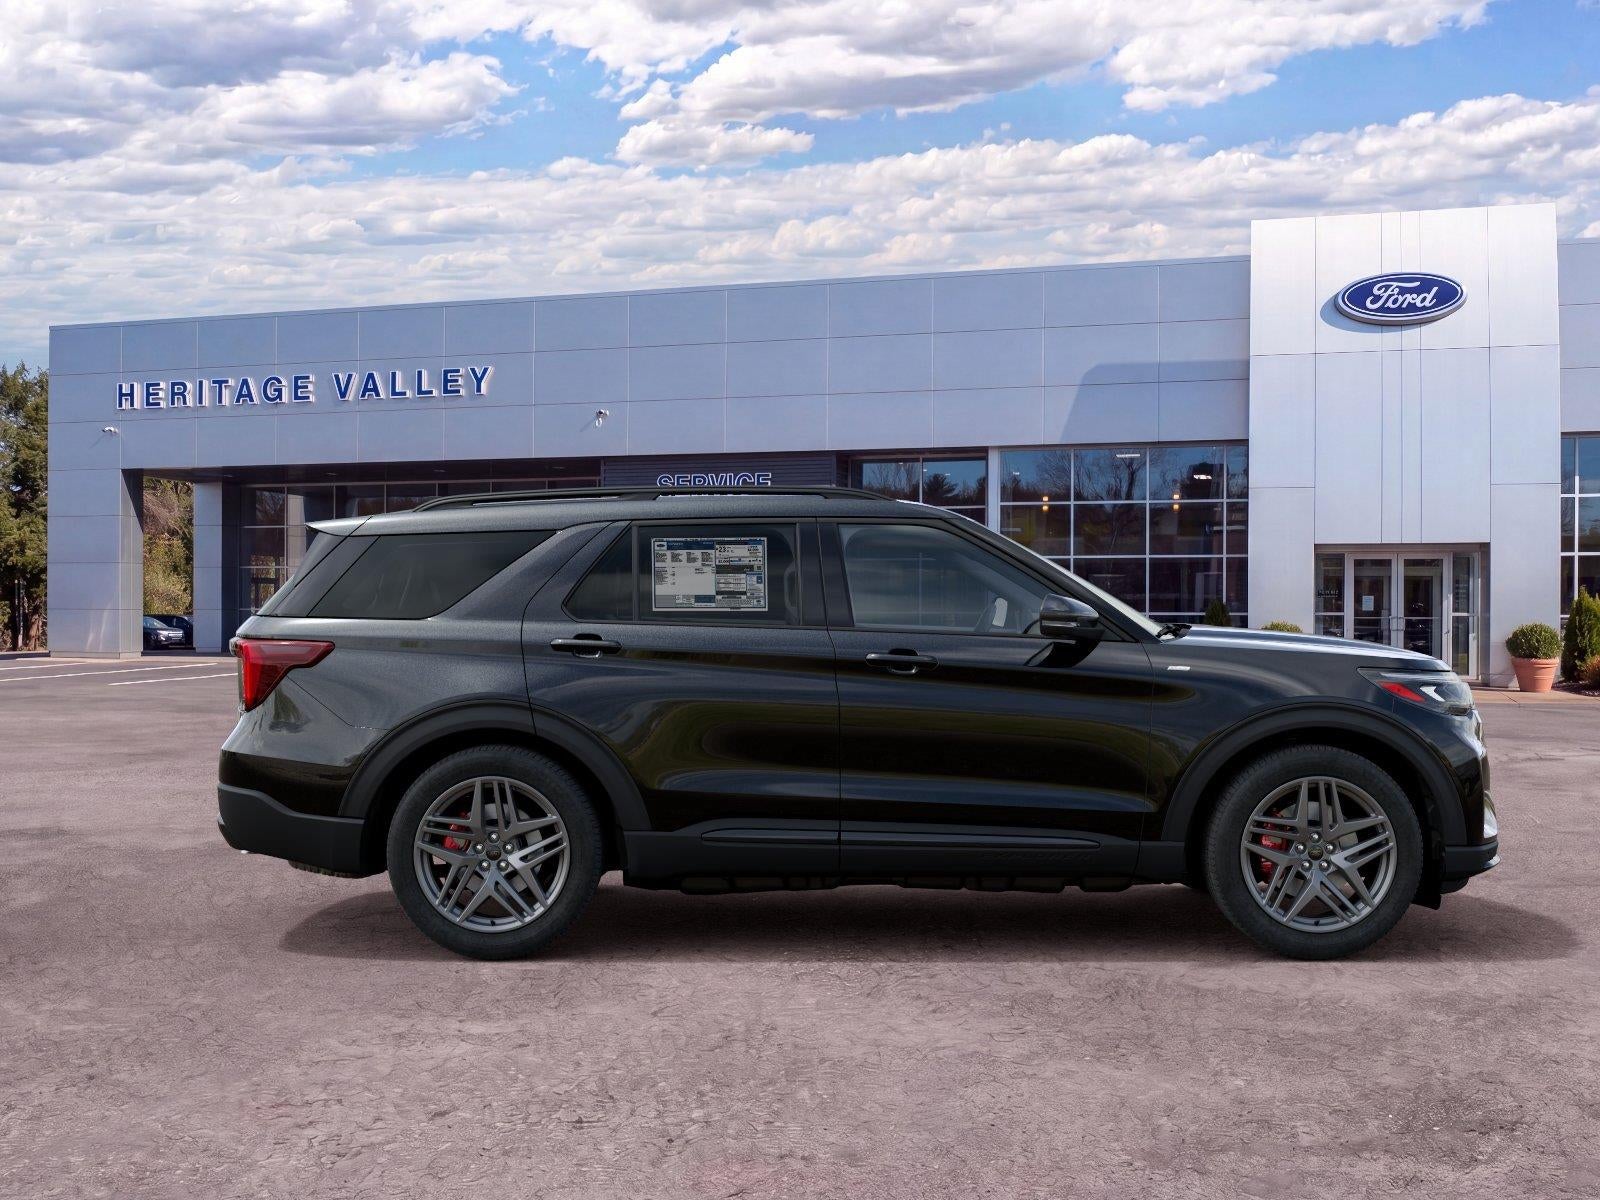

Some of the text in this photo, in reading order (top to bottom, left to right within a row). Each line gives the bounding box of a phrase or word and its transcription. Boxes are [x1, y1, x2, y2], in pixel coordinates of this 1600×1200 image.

[1365, 281, 1439, 310] Ford
[116, 366, 492, 411] HERITAGE VALLEY
[656, 472, 772, 487] SERVICE
